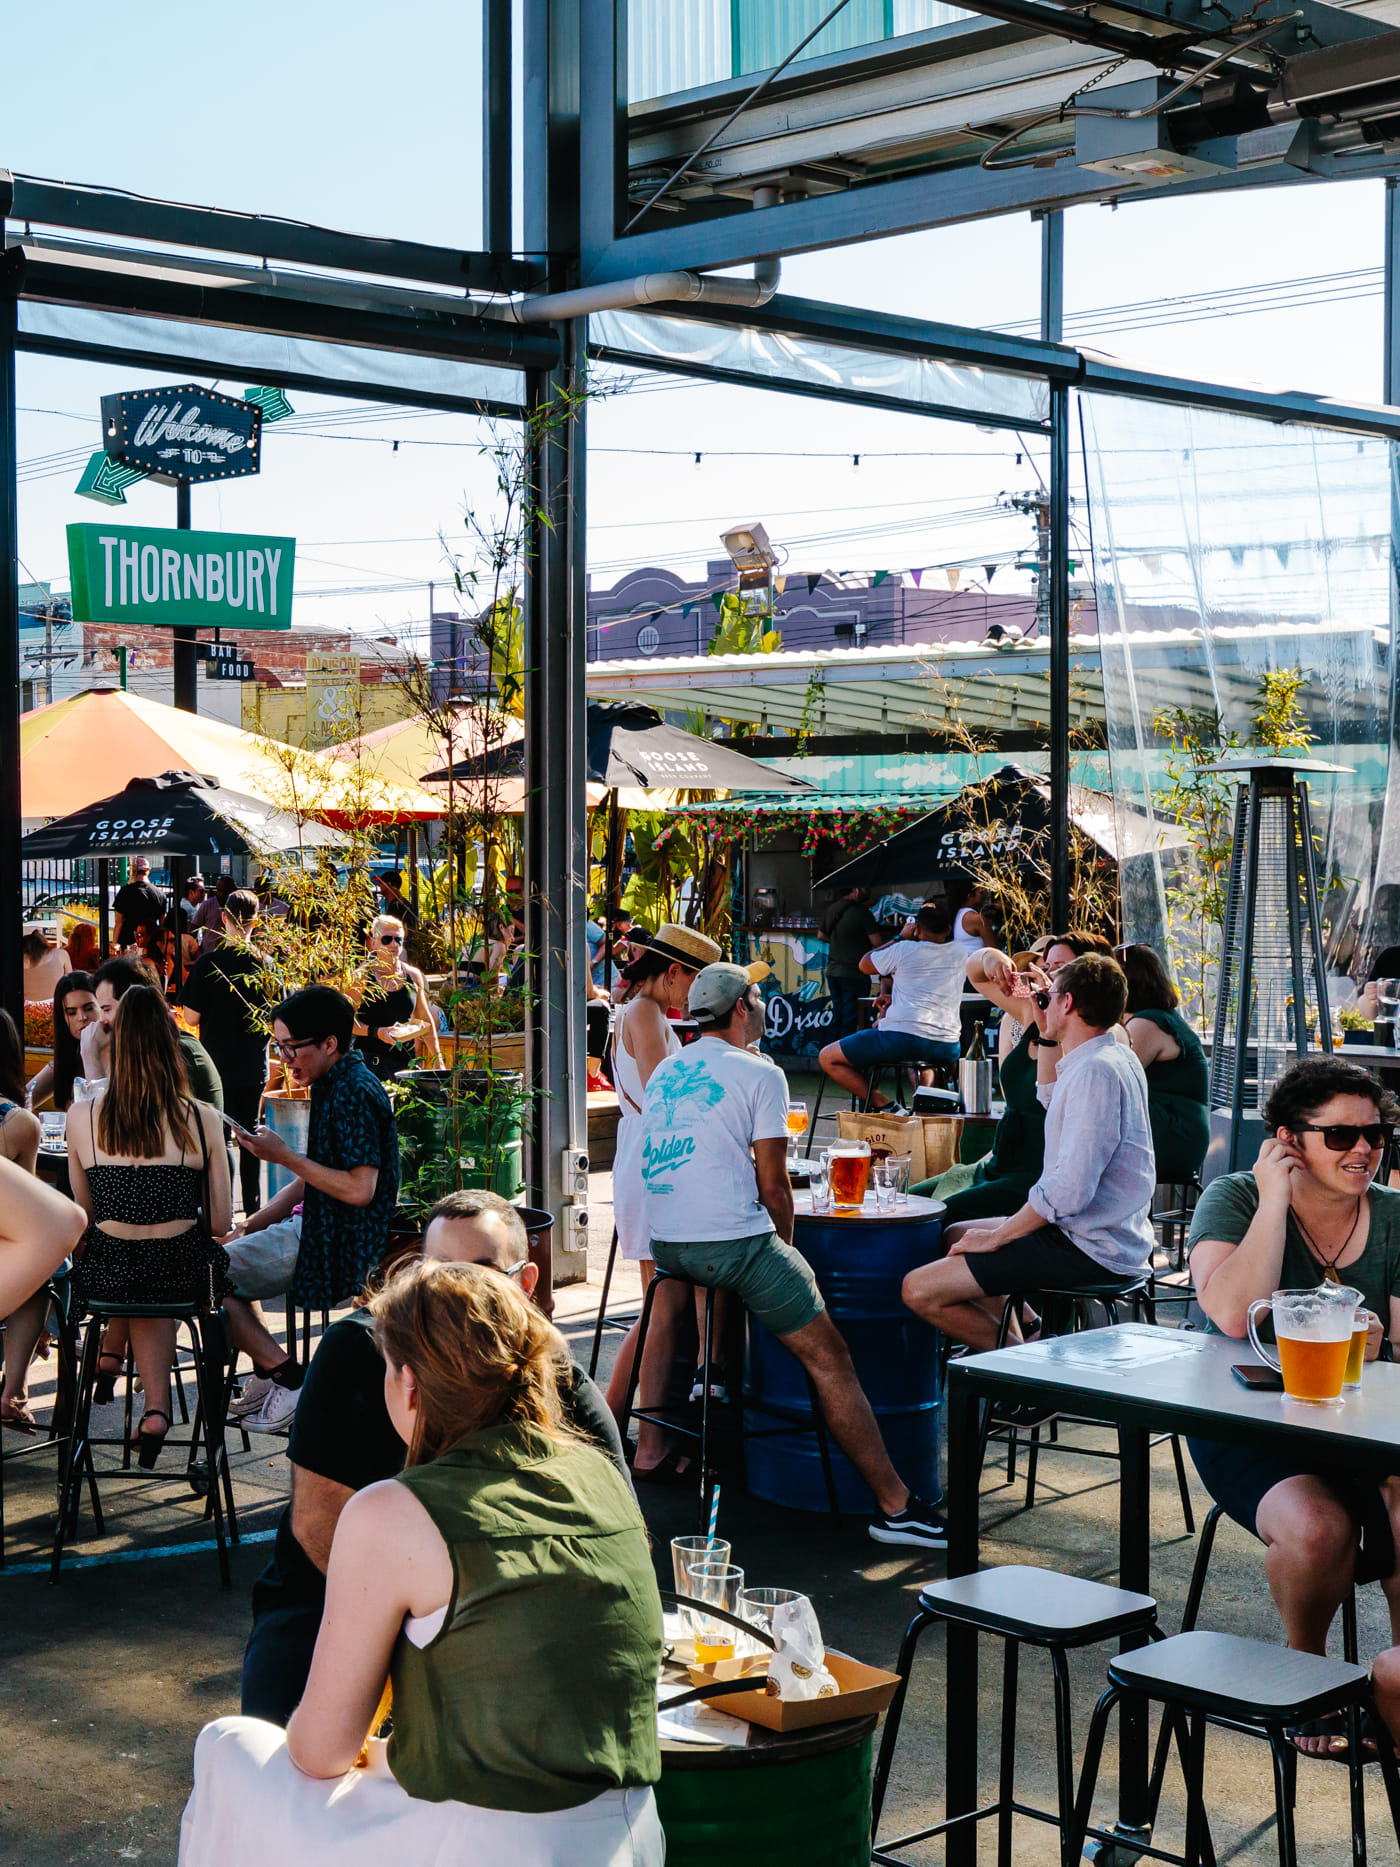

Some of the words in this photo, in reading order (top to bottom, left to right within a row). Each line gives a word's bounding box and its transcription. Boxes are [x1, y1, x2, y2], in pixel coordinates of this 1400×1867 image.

[133, 401, 248, 454] Welcome
[182, 448, 202, 465] TO
[98, 536, 282, 616] THORNBURY
[210, 644, 232, 659] BAR
[221, 663, 249, 678] FOOD
[639, 751, 700, 762] GOOSE
[647, 762, 709, 772] ISLAND
[95, 817, 175, 830] GOOSE
[88, 829, 168, 841] ISLAND
[936, 840, 1018, 860] ISLAND
